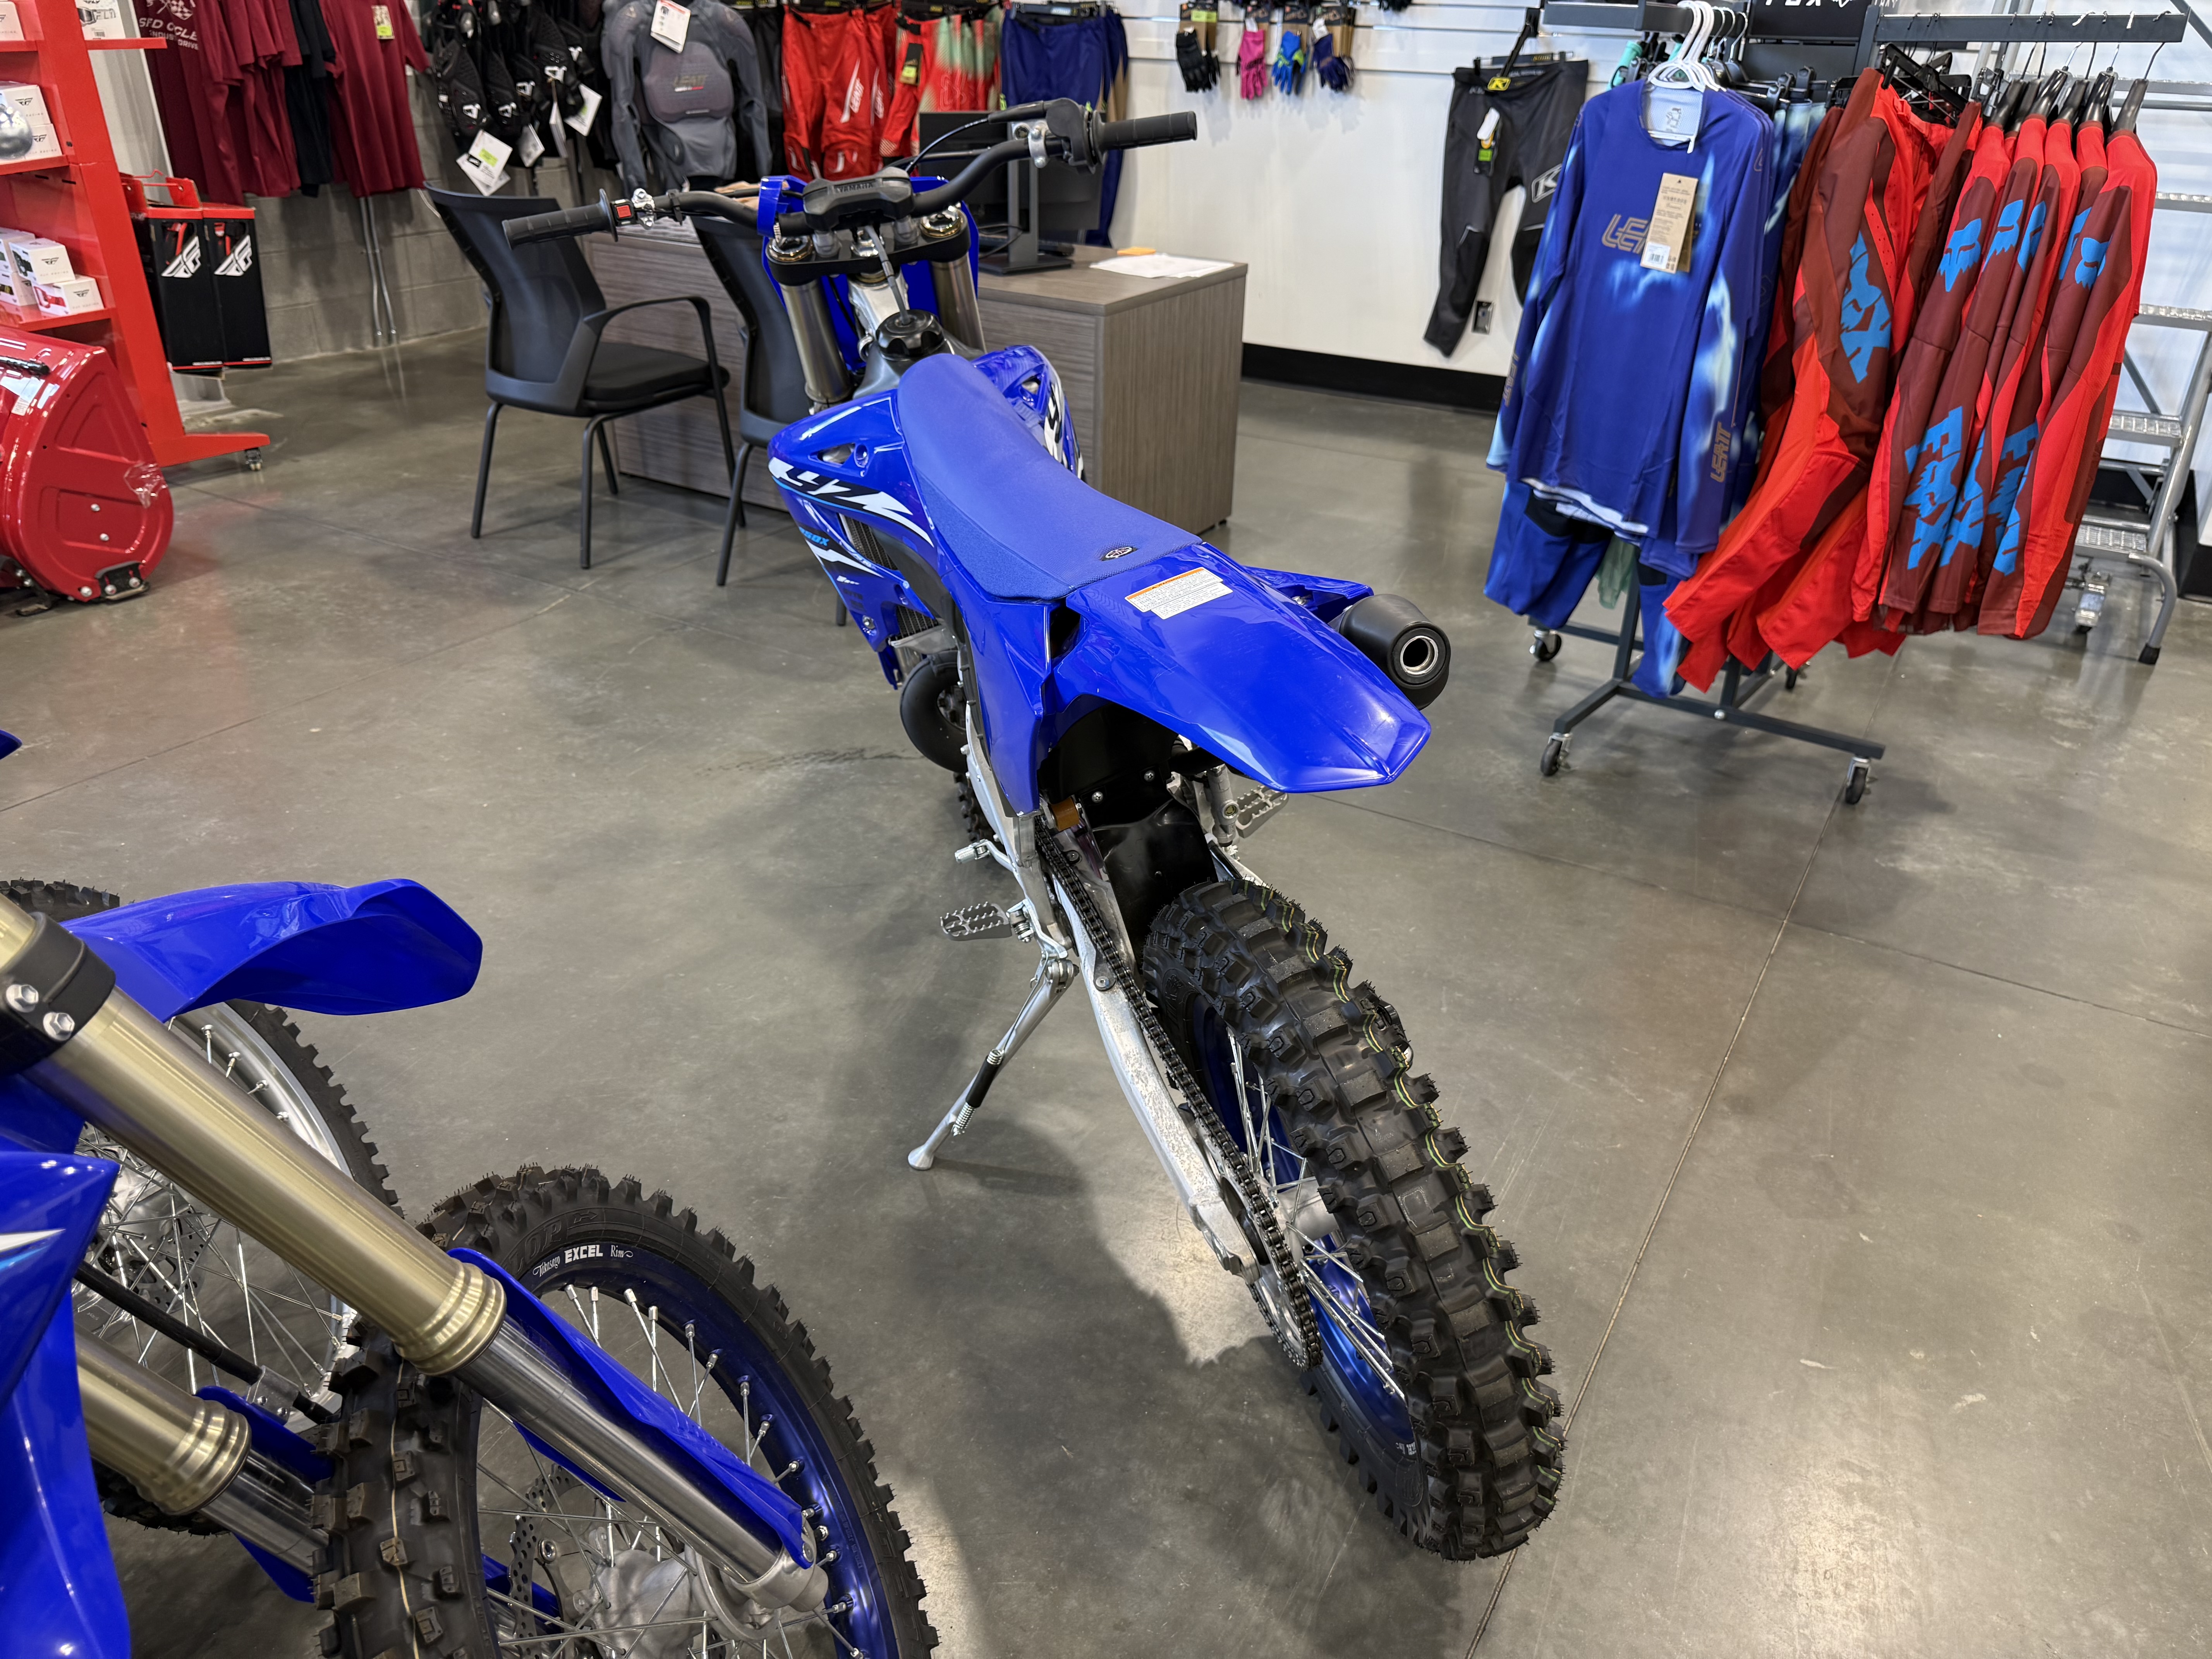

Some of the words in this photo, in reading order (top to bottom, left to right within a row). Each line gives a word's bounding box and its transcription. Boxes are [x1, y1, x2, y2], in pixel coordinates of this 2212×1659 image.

[139, 17, 164, 29] SFD
[167, 22, 198, 41] CCLE
[836, 182, 873, 192] YAMAHA
[1710, 421, 1731, 483] LEATT
[532, 1255, 560, 1277] Takasago
[564, 1244, 603, 1264] EXCEL
[610, 1245, 633, 1258] Rim
